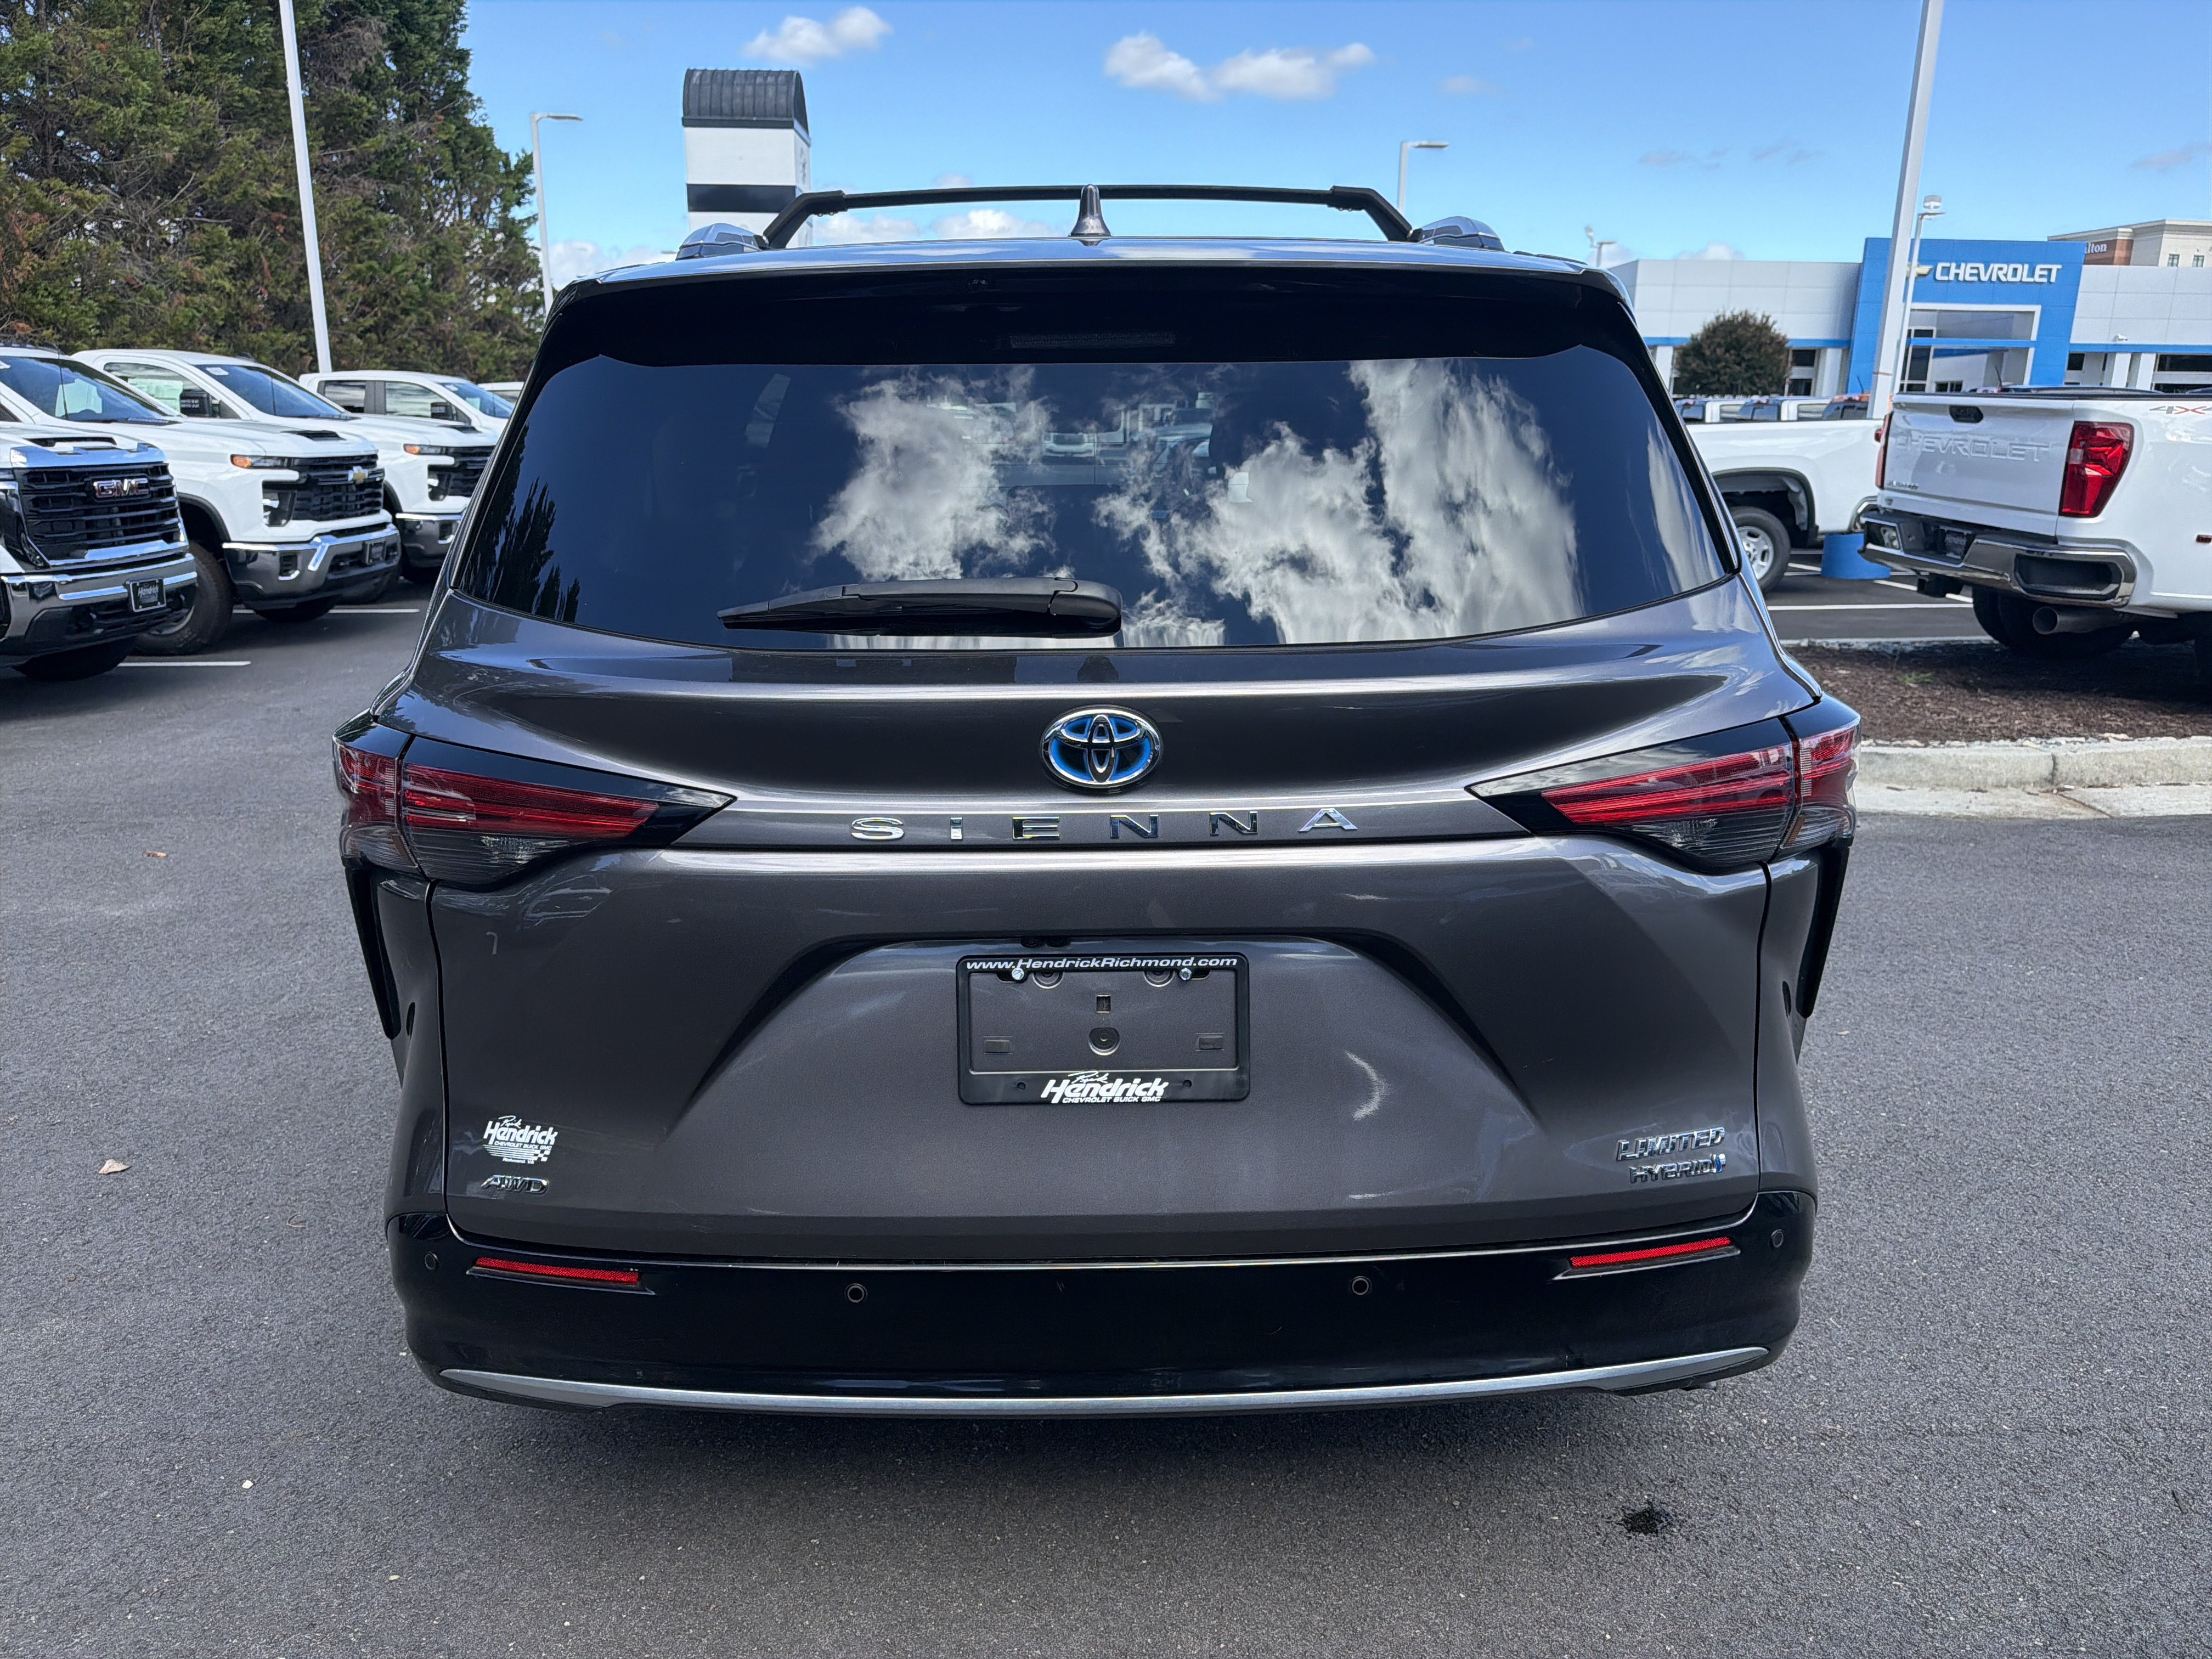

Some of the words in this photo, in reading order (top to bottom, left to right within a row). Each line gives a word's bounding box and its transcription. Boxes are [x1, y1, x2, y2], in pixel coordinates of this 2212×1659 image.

[2084, 242, 2107, 255] ilton
[1936, 262, 2062, 283] CHEVROLET
[1894, 435, 2050, 462] CHEVROLET
[93, 478, 149, 498] GMC
[851, 808, 1358, 840] SIENNA
[967, 957, 1238, 970] www.HendrickRichmond.com
[1041, 1078, 1169, 1103] Hendrick
[483, 1121, 558, 1145] Hendrick
[1616, 1126, 1725, 1162] LIMITED
[1629, 1158, 1713, 1183] HYBRID
[481, 1175, 550, 1194] AWD
